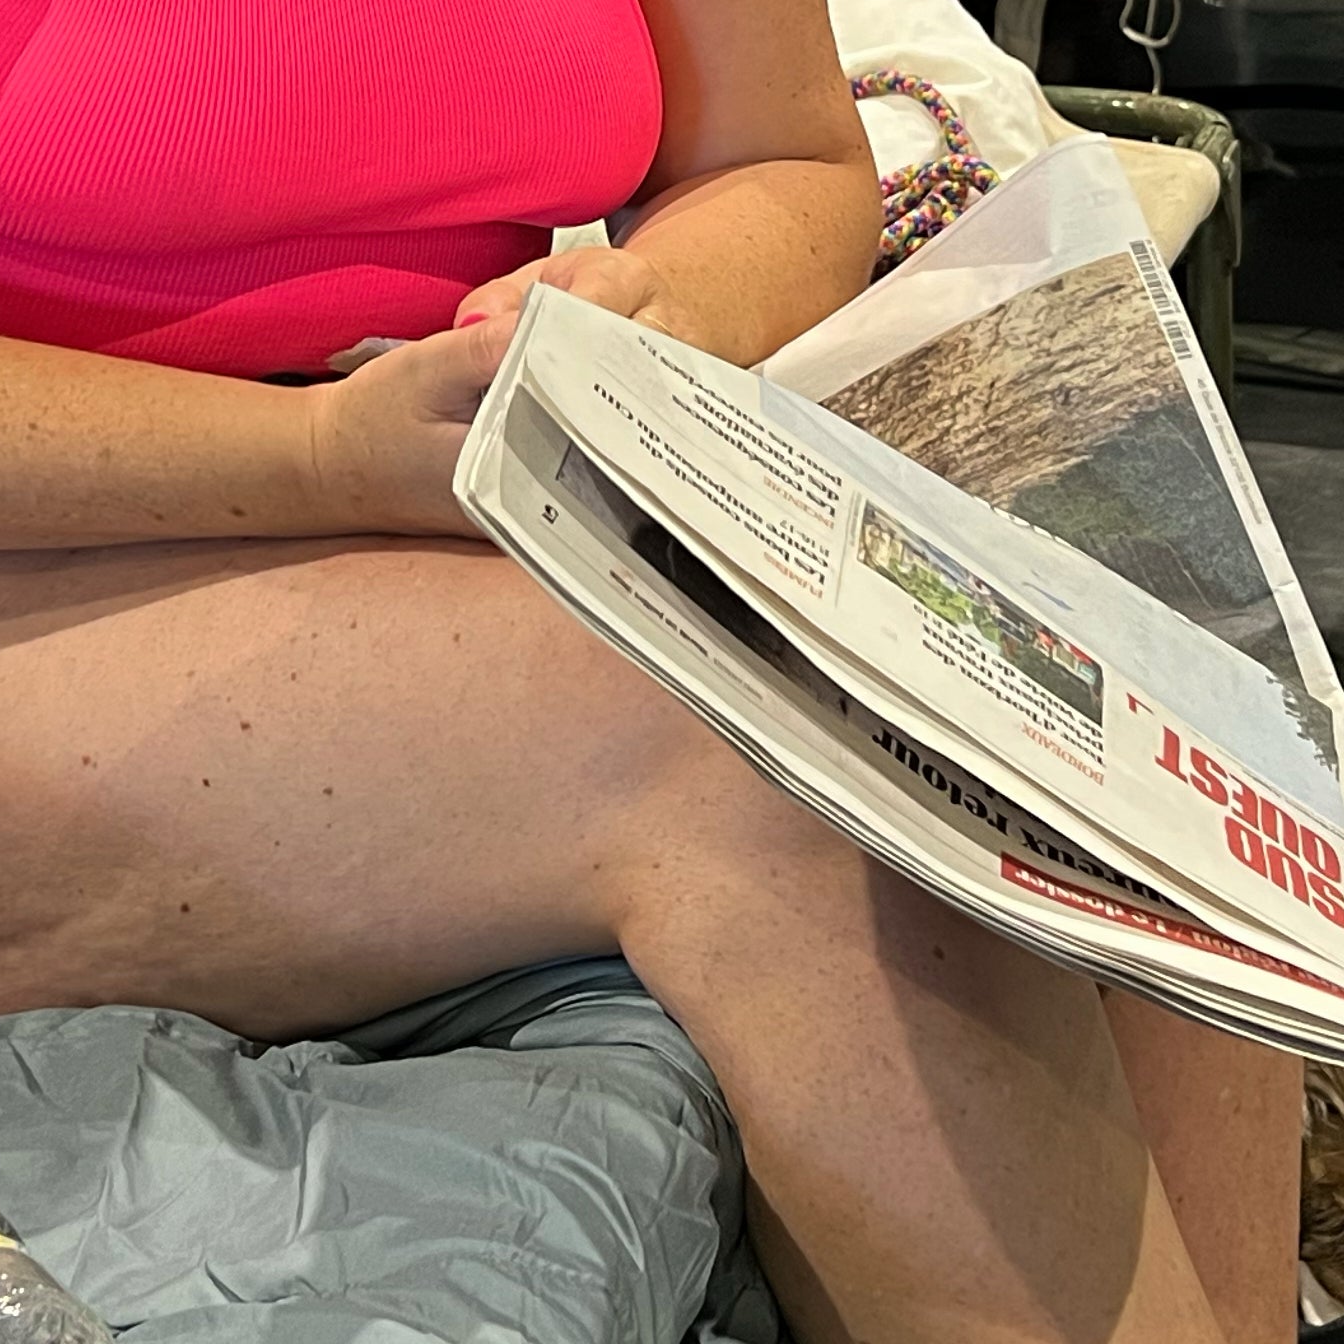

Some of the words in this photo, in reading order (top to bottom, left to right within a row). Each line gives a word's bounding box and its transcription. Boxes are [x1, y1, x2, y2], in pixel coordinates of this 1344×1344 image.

[594, 383, 634, 420] CHU
[637, 420, 660, 443] du
[640, 436, 663, 459] du
[672, 394, 803, 493] conséquences
[694, 394, 805, 475] évacuations
[664, 442, 762, 524] antipoison
[666, 459, 740, 522] conseils
[808, 474, 839, 501] des
[542, 504, 559, 524] 5
[806, 492, 835, 517] Les
[744, 520, 790, 561] bons
[767, 523, 828, 567] centre
[794, 556, 825, 585] Les
[922, 639, 956, 666] des
[960, 665, 1056, 731] d'horizon
[1021, 720, 1104, 786] BORDEAUX
[1060, 732, 1104, 766] Tour
[871, 727, 1009, 836] retour
[1155, 724, 1343, 884] OUEST
[1020, 826, 1172, 906] ureux
[1014, 867, 1124, 919] dossier
[1132, 911, 1168, 934] Le
